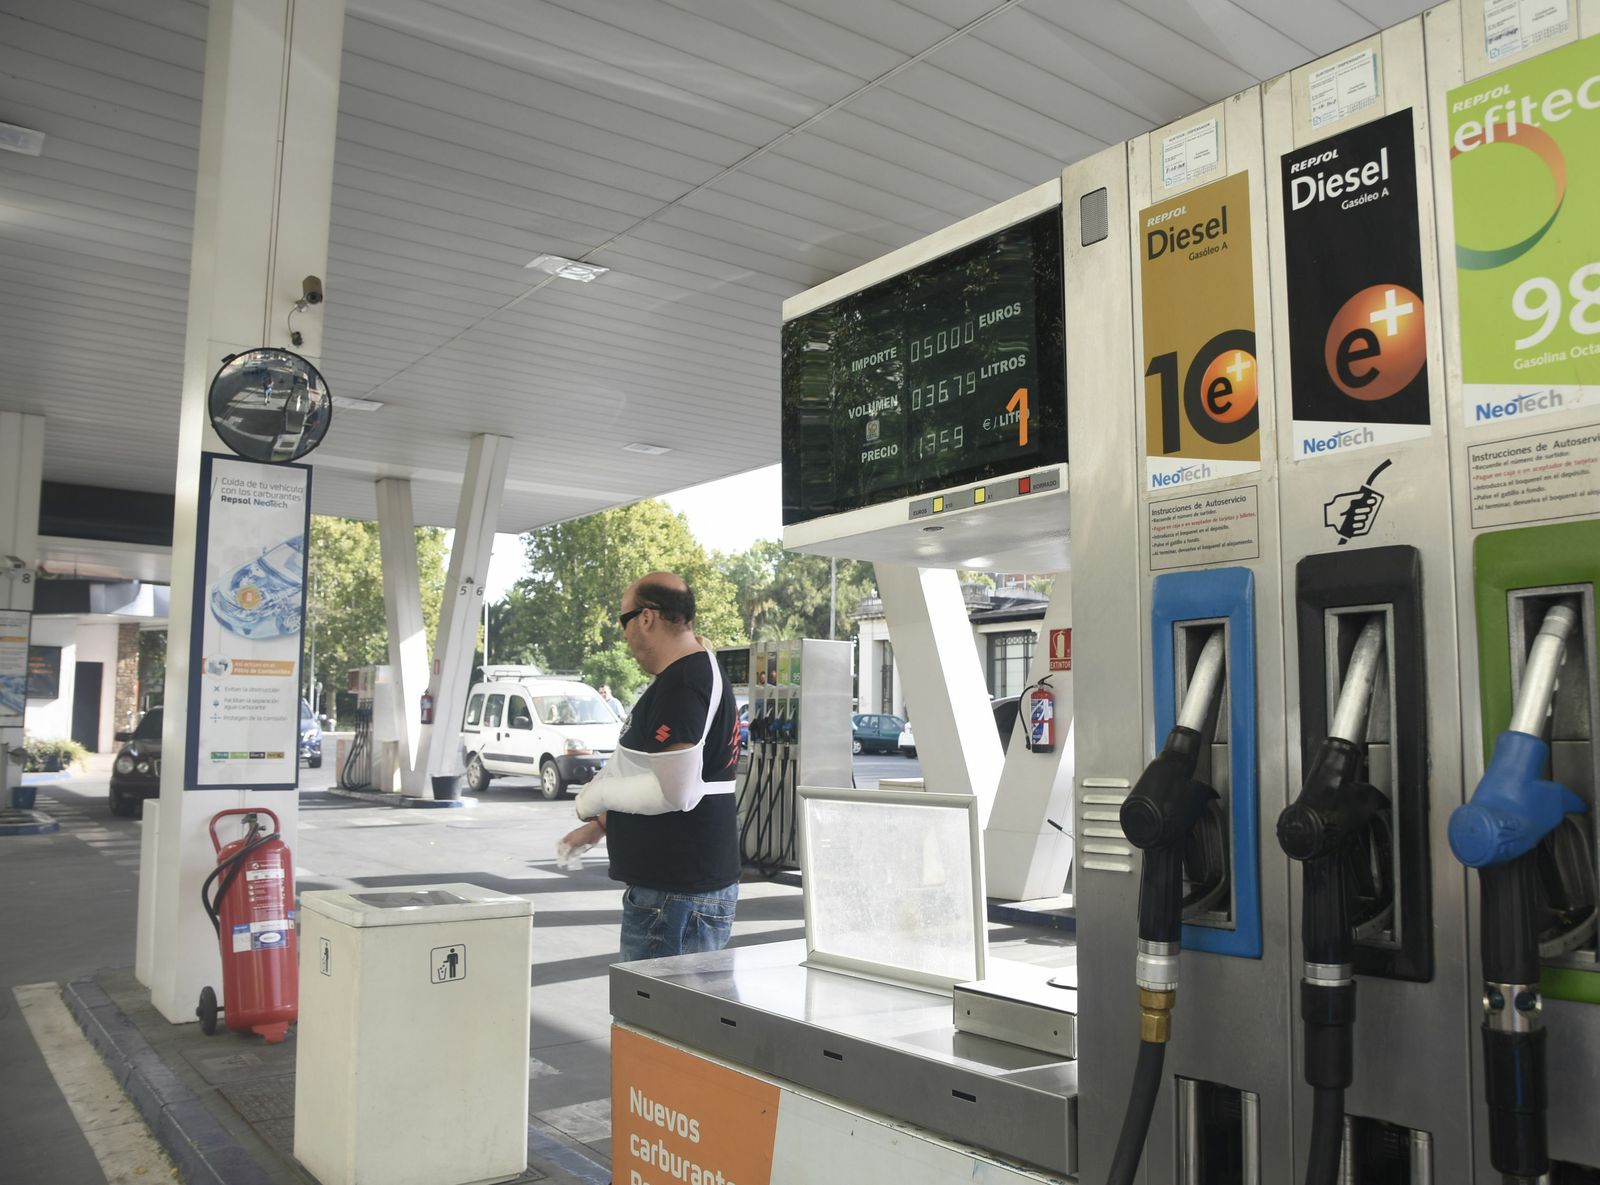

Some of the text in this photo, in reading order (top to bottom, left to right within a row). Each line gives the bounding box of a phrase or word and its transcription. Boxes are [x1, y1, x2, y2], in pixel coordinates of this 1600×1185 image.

[1452, 83, 1511, 113] REPSOL
[1291, 149, 1339, 174] REPSOL
[1291, 147, 1389, 210] Diesel
[1341, 187, 1389, 209] Gasóleo A
[1147, 206, 1187, 227] REPSOL
[1148, 206, 1227, 260] Diesel
[1188, 242, 1228, 261] Gasóleo A
[979, 302, 1021, 328] EUROS
[1512, 262, 1600, 350] 98
[852, 347, 897, 372] IMPORTE
[981, 354, 1026, 379] LITROS
[1514, 351, 1567, 370] Gasolina
[848, 395, 898, 419] VOLUMEN
[1006, 388, 1028, 446] 1
[862, 444, 898, 463] PRECIO
[1472, 446, 1531, 462] Instrucciones
[1536, 443, 1547, 451] de
[221, 477, 244, 486] Cuida
[247, 480, 257, 488] de
[221, 495, 251, 505] Repsol
[239, 488, 251, 496] los
[253, 490, 301, 501] carburantes
[1152, 504, 1191, 516] Instrucciones
[1206, 496, 1246, 508] Autoservicio
[22, 573, 30, 583] 8
[460, 586, 467, 595] 5
[476, 587, 483, 596] 6
[1050, 661, 1071, 670] EXTINTOR
[630, 1086, 700, 1143] Nuevos
[630, 1134, 736, 1185] carburant
